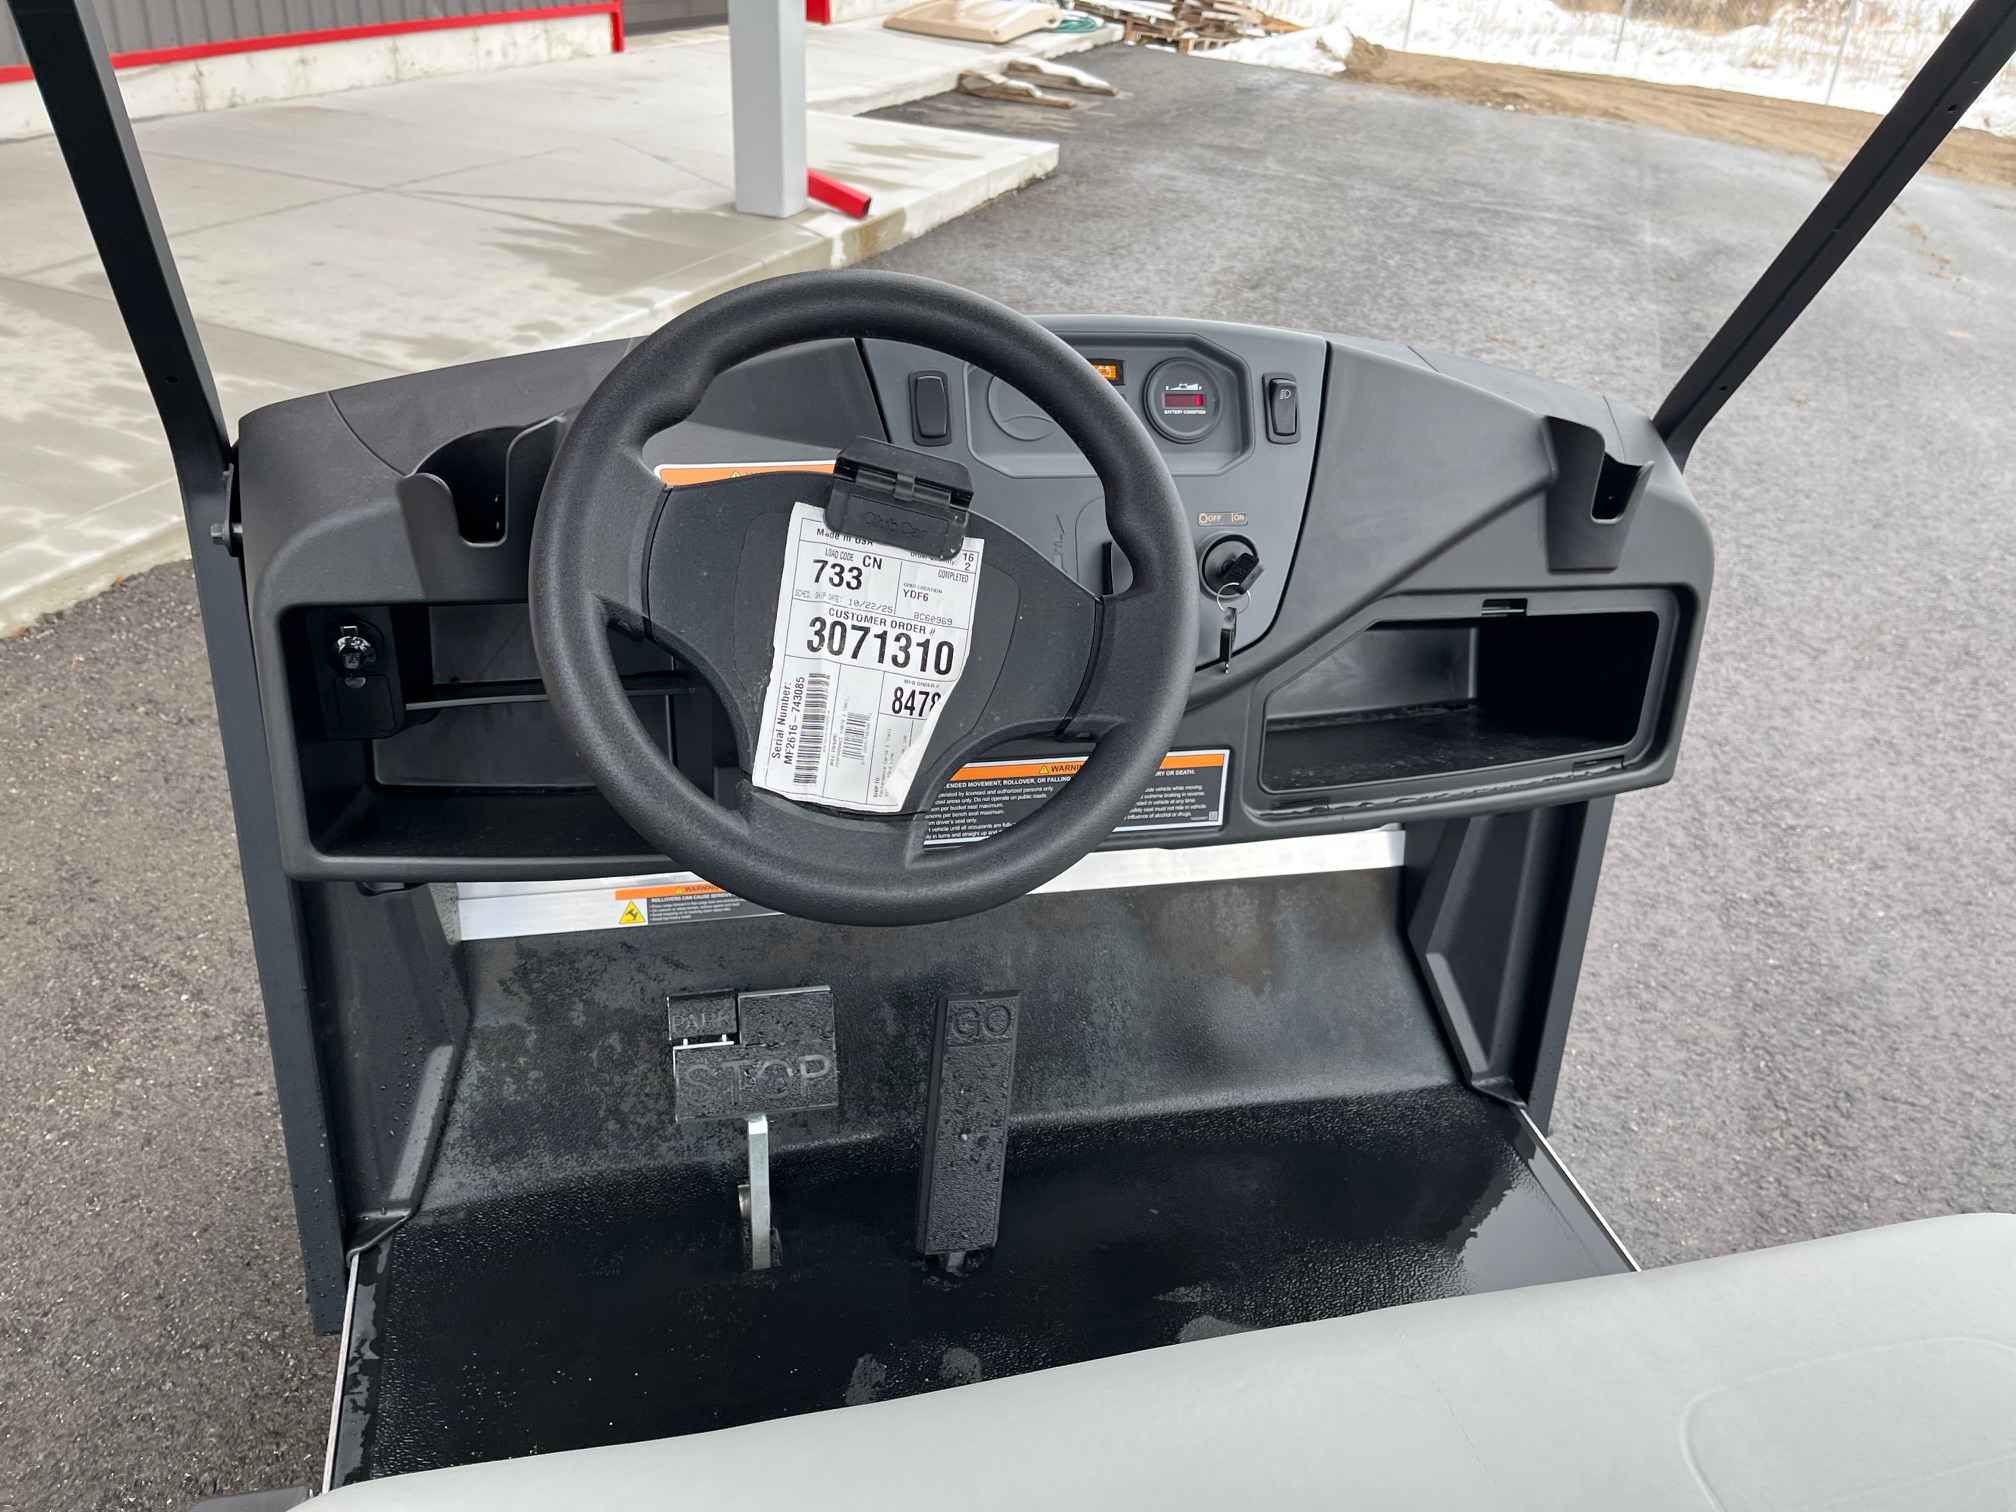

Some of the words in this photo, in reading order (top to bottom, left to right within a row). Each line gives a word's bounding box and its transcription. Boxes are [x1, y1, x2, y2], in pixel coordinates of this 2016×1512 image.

[863, 511, 898, 532] Club
[901, 521, 929, 540] Car
[825, 547, 839, 559] LOAD
[840, 550, 855, 562] CODE
[862, 555, 883, 570] CN
[963, 553, 974, 562] 16
[813, 559, 863, 590] 733
[938, 570, 969, 583] COMPLETED
[964, 562, 971, 571] 2
[848, 598, 894, 614] 10/22/25
[903, 588, 929, 602] YDF6
[828, 607, 887, 627] CUSTOMER
[890, 620, 926, 635] ORDER
[806, 616, 954, 676] 3071310
[776, 681, 793, 726] Number:
[772, 728, 784, 760] Serial
[968, 780, 1002, 788] MOVEMENT,
[671, 1009, 734, 1031] PARK
[952, 1004, 1012, 1040] GO
[685, 1053, 831, 1106] STOP
